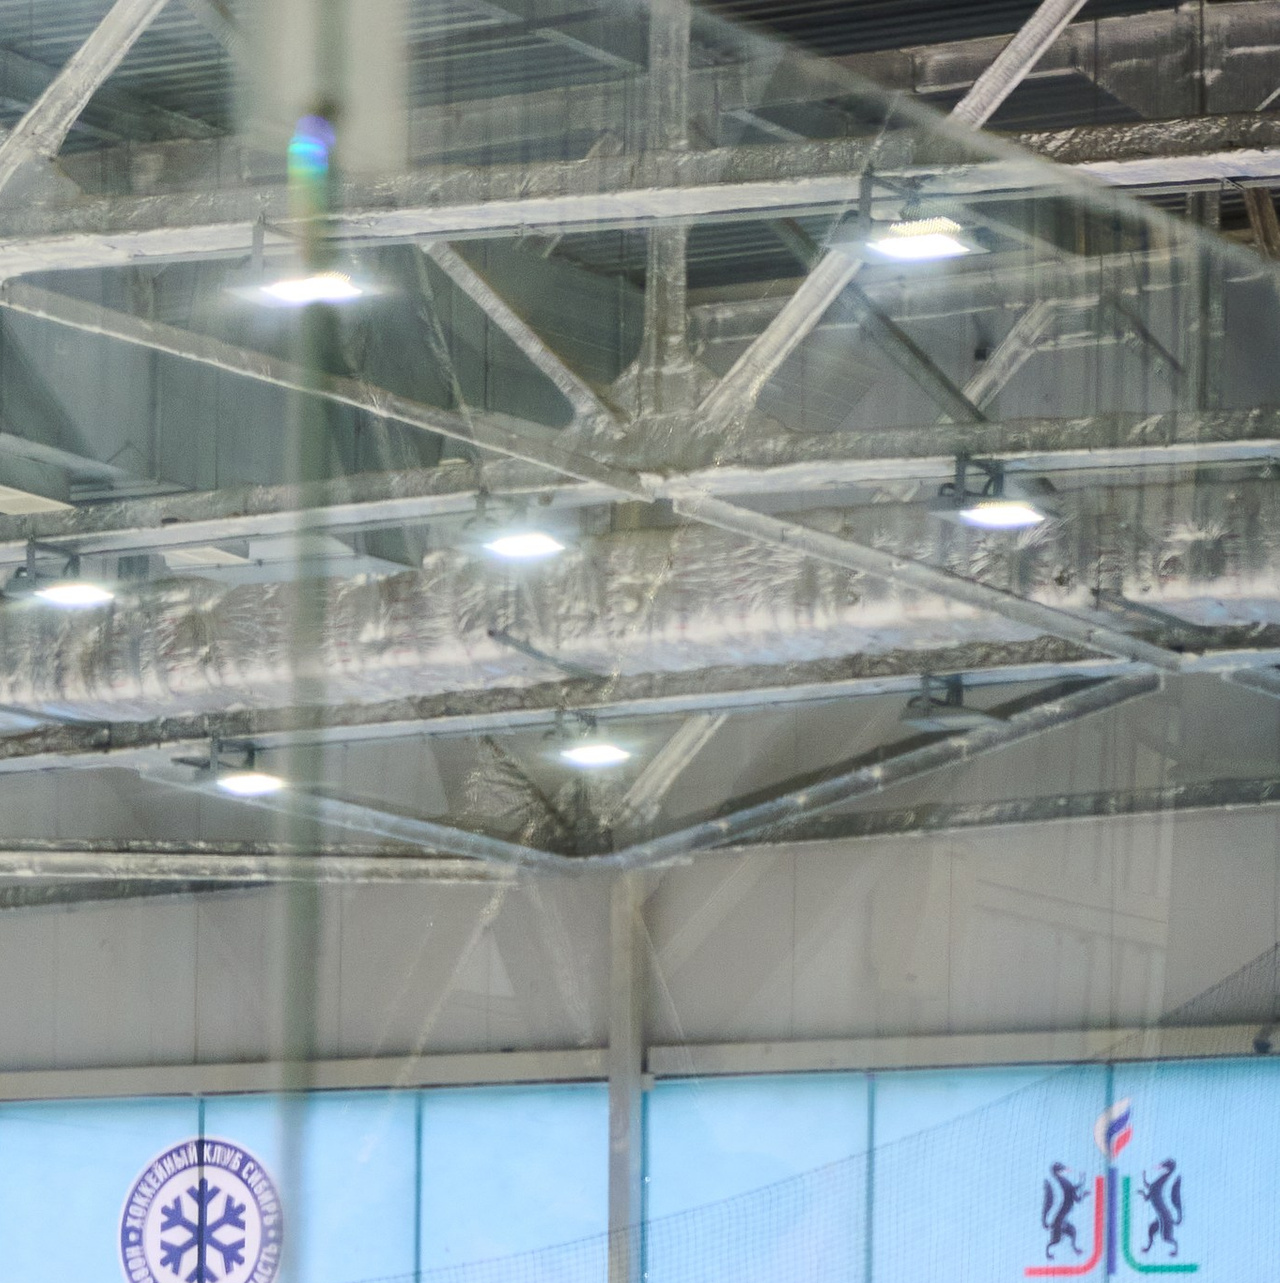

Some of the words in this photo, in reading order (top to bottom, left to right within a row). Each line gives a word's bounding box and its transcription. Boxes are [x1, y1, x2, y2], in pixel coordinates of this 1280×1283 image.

[126, 1142, 198, 1228] ХОККЕЙНЫЙ
[204, 1143, 242, 1171] КЛУБ
[241, 1163, 278, 1226] СИБИРЬ
